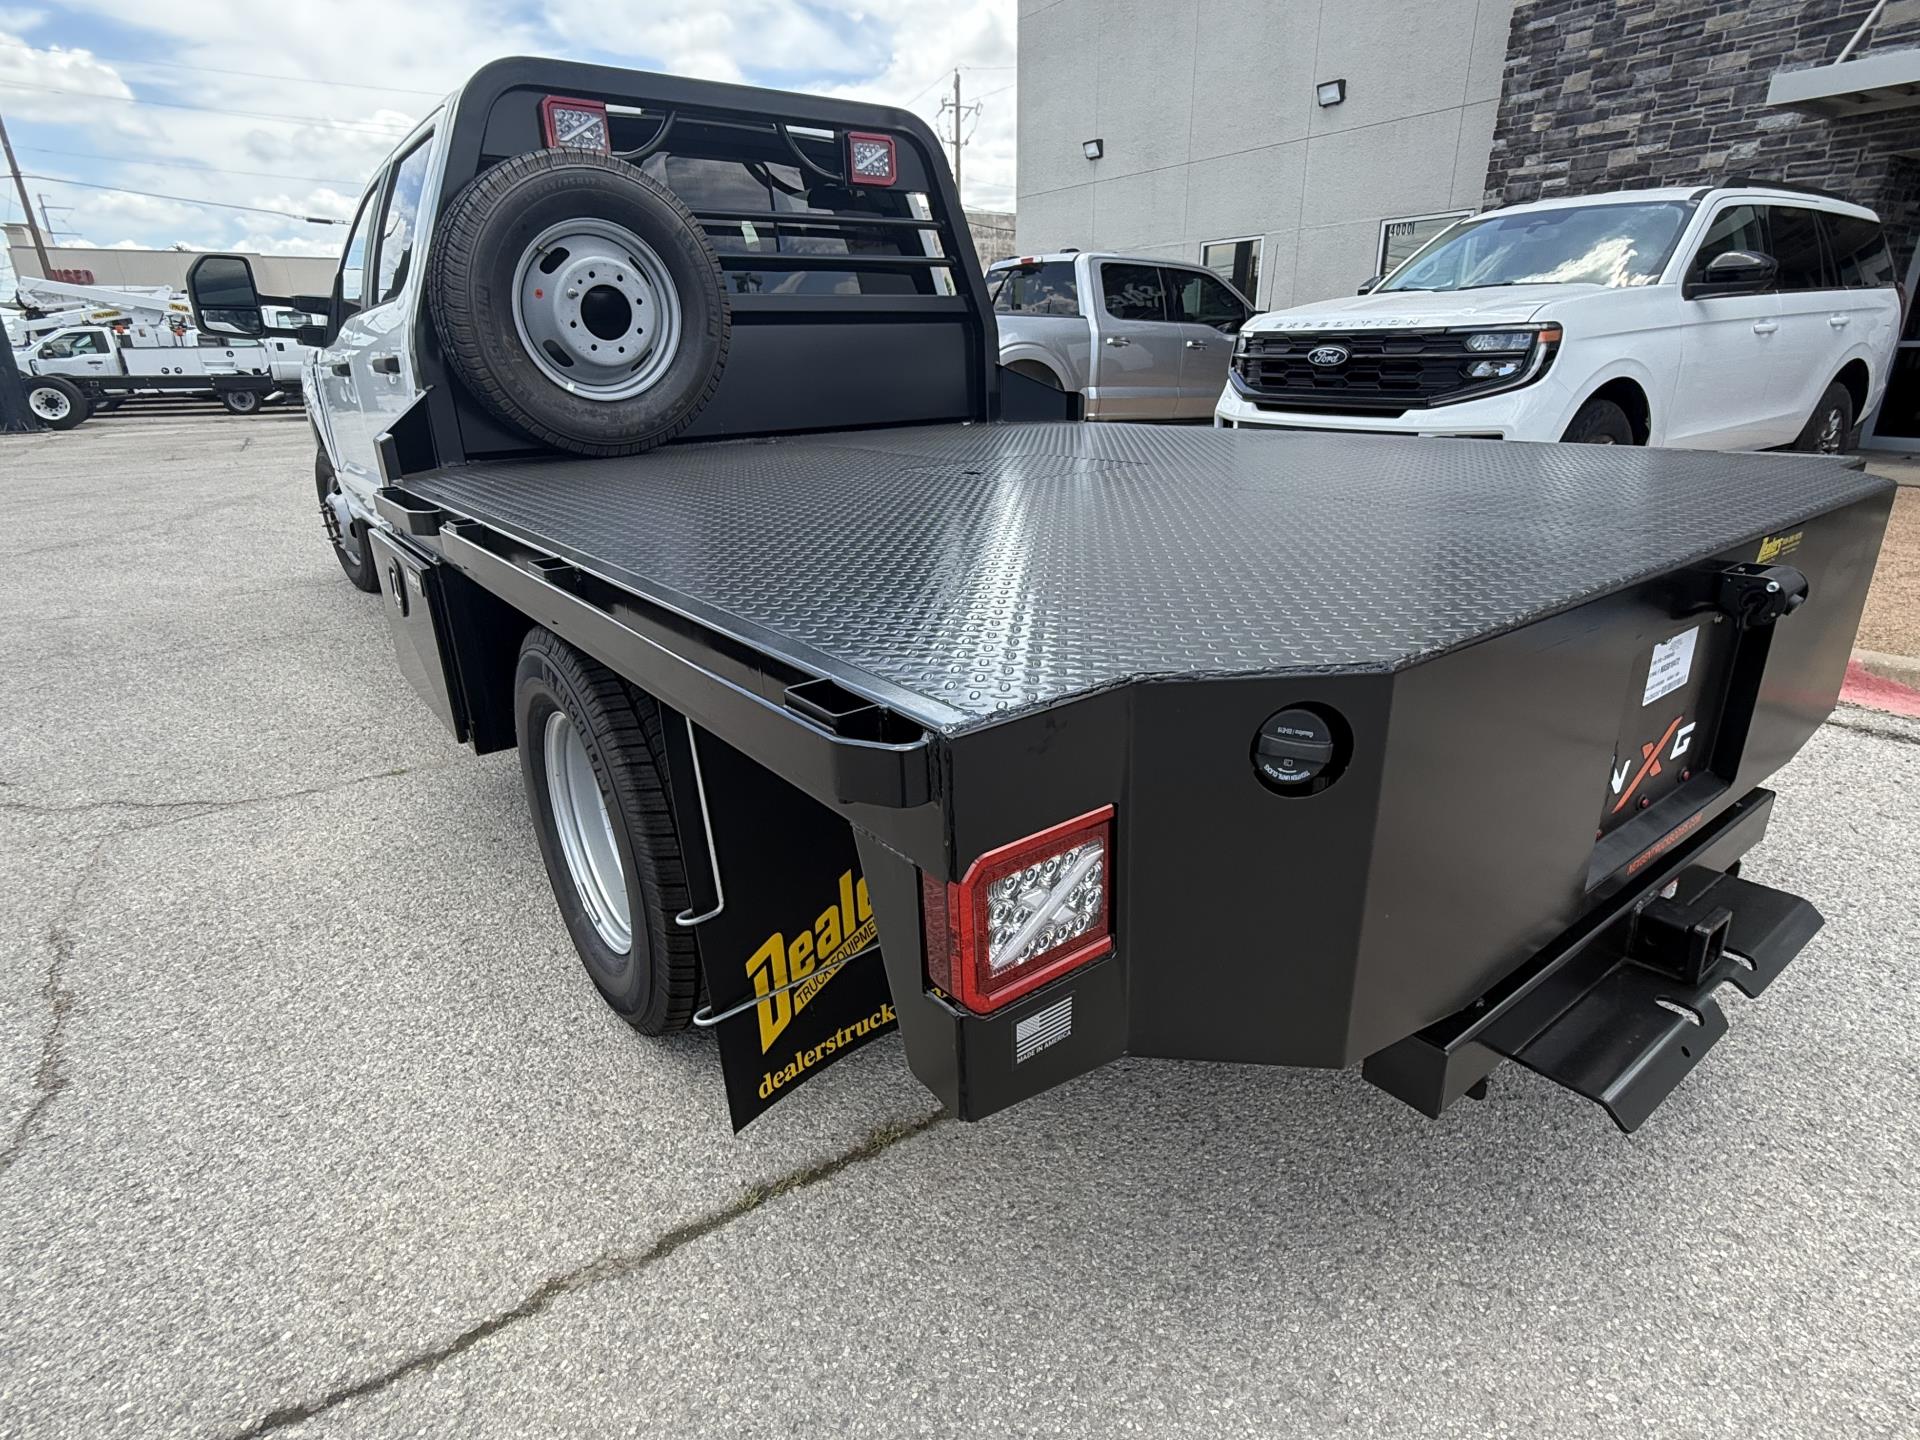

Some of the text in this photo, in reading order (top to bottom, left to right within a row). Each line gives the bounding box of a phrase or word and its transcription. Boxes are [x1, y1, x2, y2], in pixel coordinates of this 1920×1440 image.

[1273, 319, 1421, 329] EXPEDITION
[1314, 350, 1340, 364] Ford
[1264, 764, 1310, 781] TIGHTEN UNTIL CLICKS
[1017, 1029, 1072, 1064] MADE IN AMERICA
